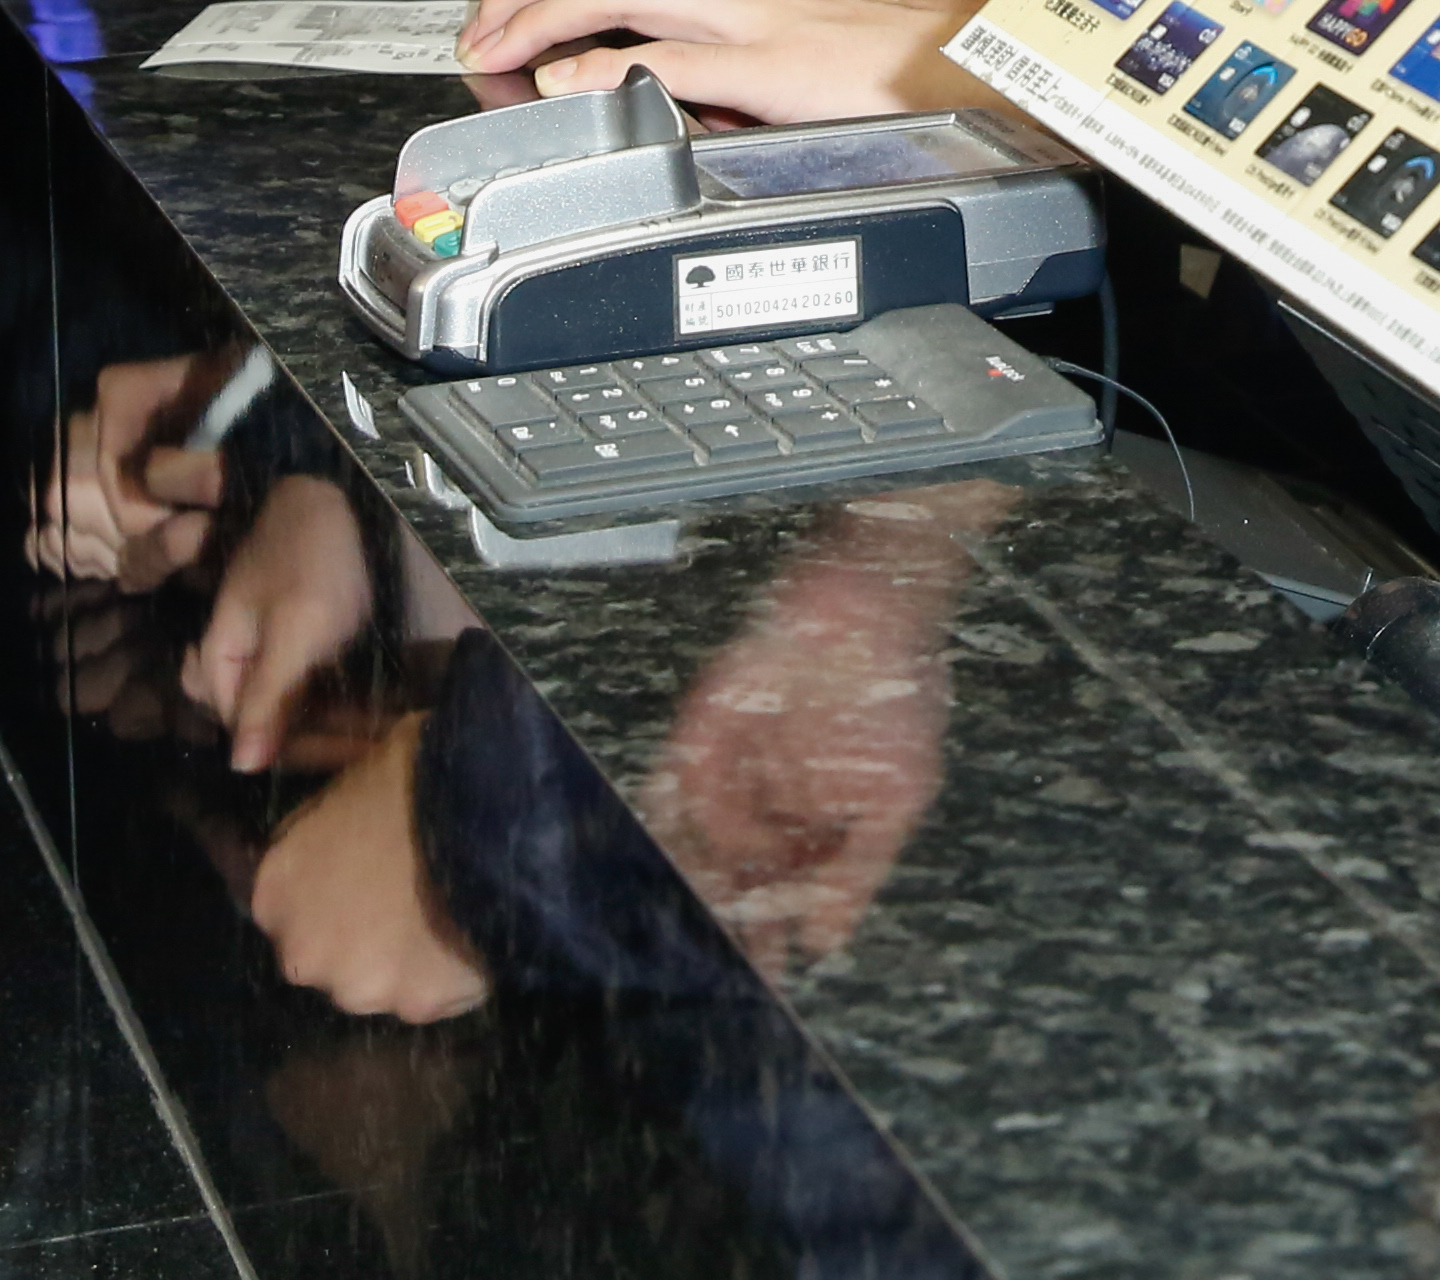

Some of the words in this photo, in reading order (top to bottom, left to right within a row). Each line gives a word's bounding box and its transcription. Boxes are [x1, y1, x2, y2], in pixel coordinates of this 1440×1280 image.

[726, 252, 850, 281] 國泰世華銀行
[717, 291, 853, 318] 50102042420260
[738, 345, 761, 356] 7
[661, 356, 680, 366] 4
[580, 367, 598, 376] 1
[764, 367, 786, 377] 8
[497, 377, 517, 386] 0
[684, 376, 706, 389] 5
[602, 388, 623, 400] 2
[792, 388, 813, 399] 9
[710, 399, 731, 410] 6
[627, 409, 649, 420] 3
